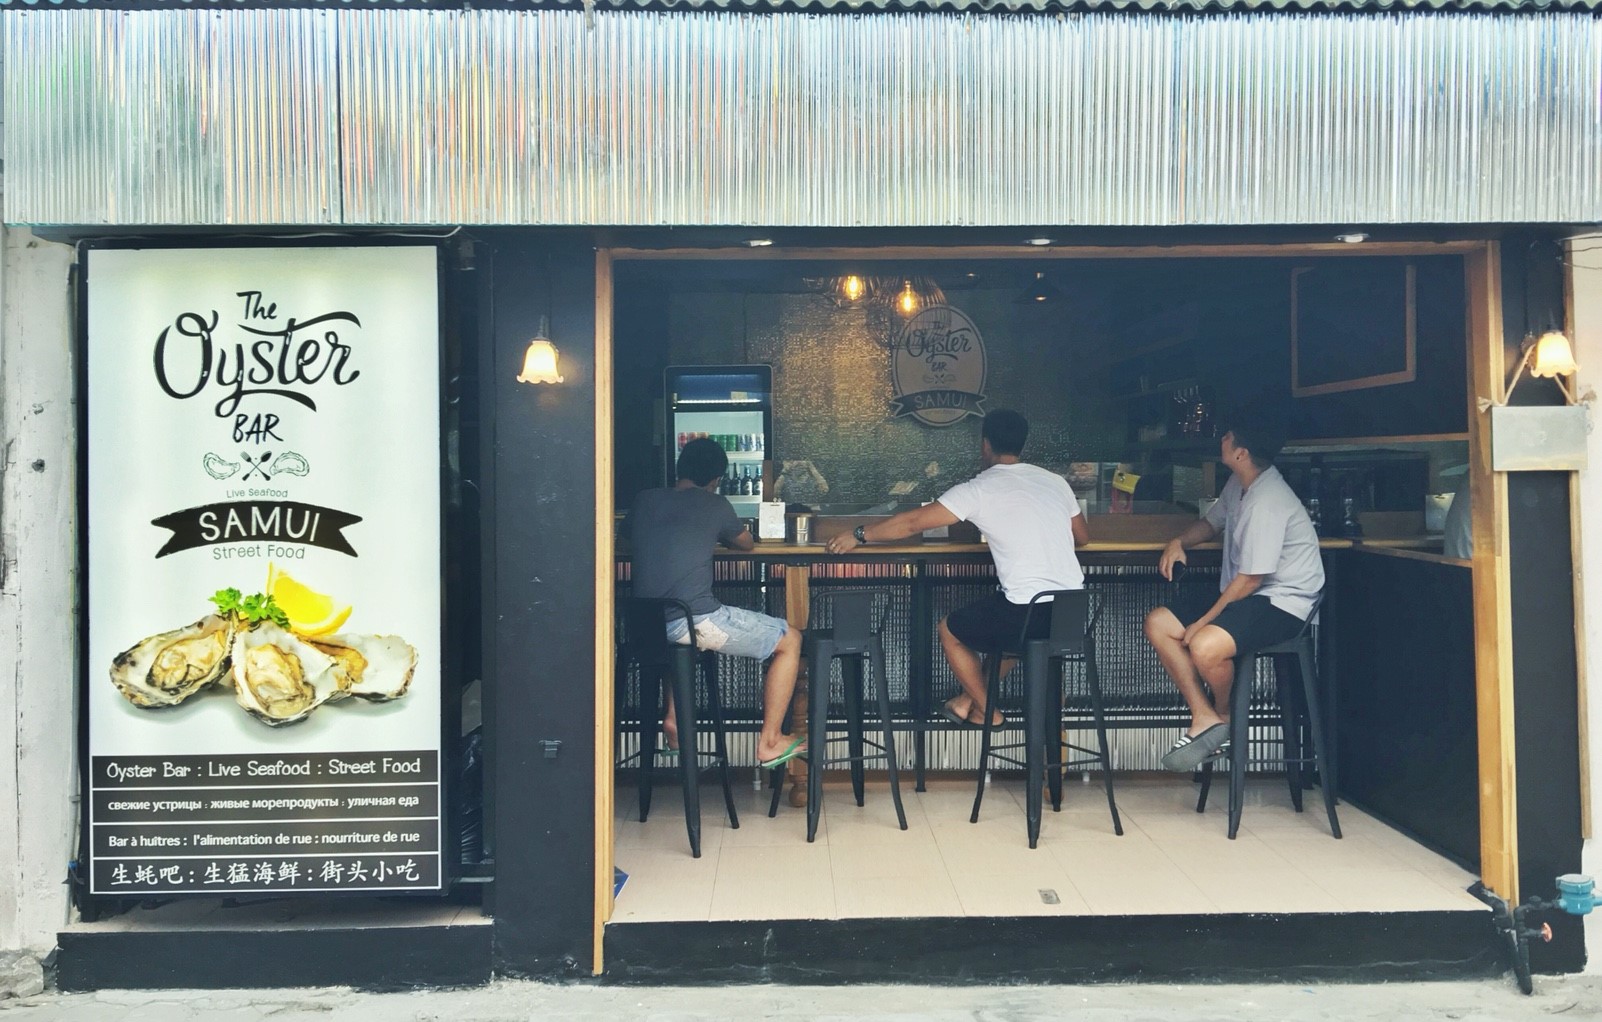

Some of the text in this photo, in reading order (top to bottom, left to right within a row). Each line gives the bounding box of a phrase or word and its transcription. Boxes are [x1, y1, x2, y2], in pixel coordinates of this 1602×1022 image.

[236, 290, 277, 320] The
[906, 327, 972, 364] Oyster
[153, 310, 361, 418] Oyster
[914, 393, 967, 409] SAMUI
[232, 413, 284, 445] BAR
[226, 488, 288, 499] Live Seafood
[199, 506, 320, 541] SAMUI
[213, 544, 305, 561] Street Food
[106, 762, 157, 782] Oyster
[162, 761, 191, 778] Bar
[208, 761, 241, 777] Live
[247, 760, 311, 776] Seafood
[328, 758, 376, 775] Street
[382, 757, 421, 774] Food
[107, 801, 150, 811] свежие
[152, 800, 202, 813] устрицы
[210, 799, 250, 809] живые
[251, 797, 339, 811] морепродукты
[347, 796, 396, 809] уличная
[398, 796, 420, 808] еда
[108, 835, 129, 847] Bar
[131, 836, 138, 847] à
[140, 834, 181, 847] huîtres
[193, 833, 273, 846] l'alimentation
[275, 833, 290, 845] de
[292, 833, 313, 845] rue
[321, 831, 380, 844] nourriture
[382, 830, 399, 843] de
[400, 832, 421, 843] rue
